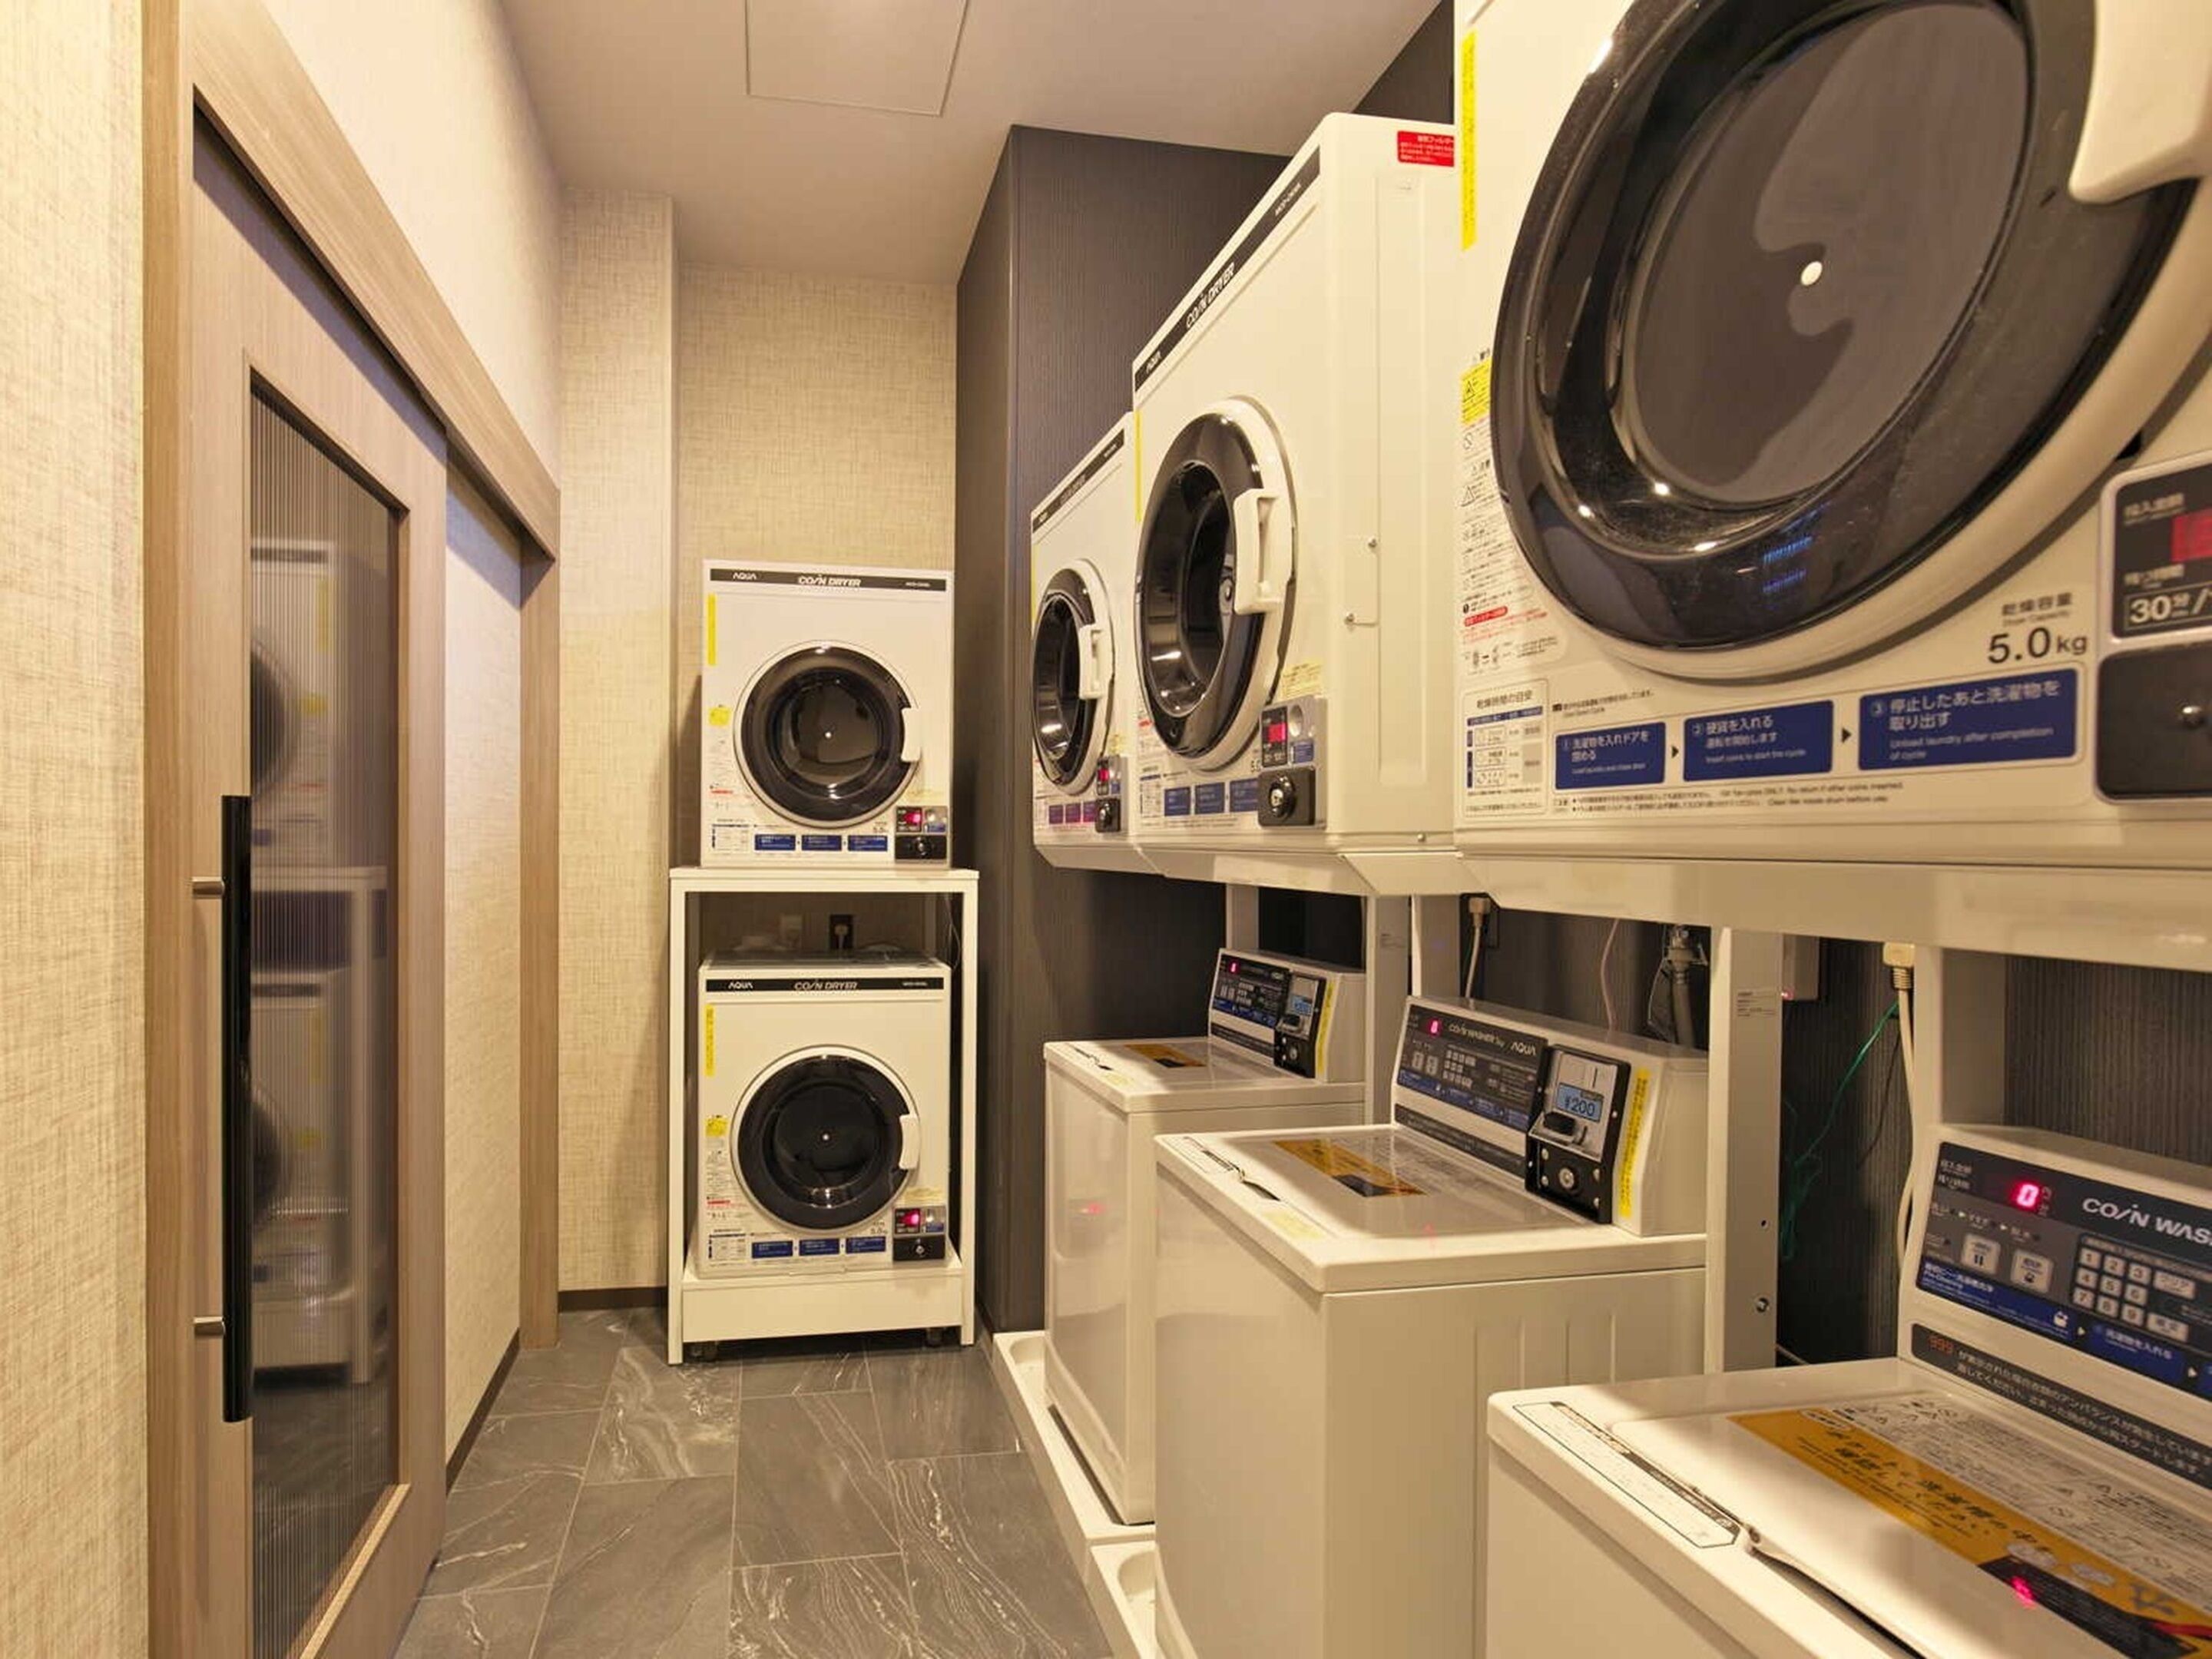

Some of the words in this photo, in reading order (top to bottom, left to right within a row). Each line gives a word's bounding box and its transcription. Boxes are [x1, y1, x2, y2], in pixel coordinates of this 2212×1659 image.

[733, 571, 757, 581] AQUA
[828, 578, 861, 587] DRYER
[1889, 711, 1951, 731] 取り出す
[728, 981, 753, 990] AQUA
[825, 981, 859, 990] DRYER
[1511, 1041, 1537, 1057] AQUA
[2016, 1183, 2040, 1208] 0
[2154, 1216, 2212, 1247] WAS
